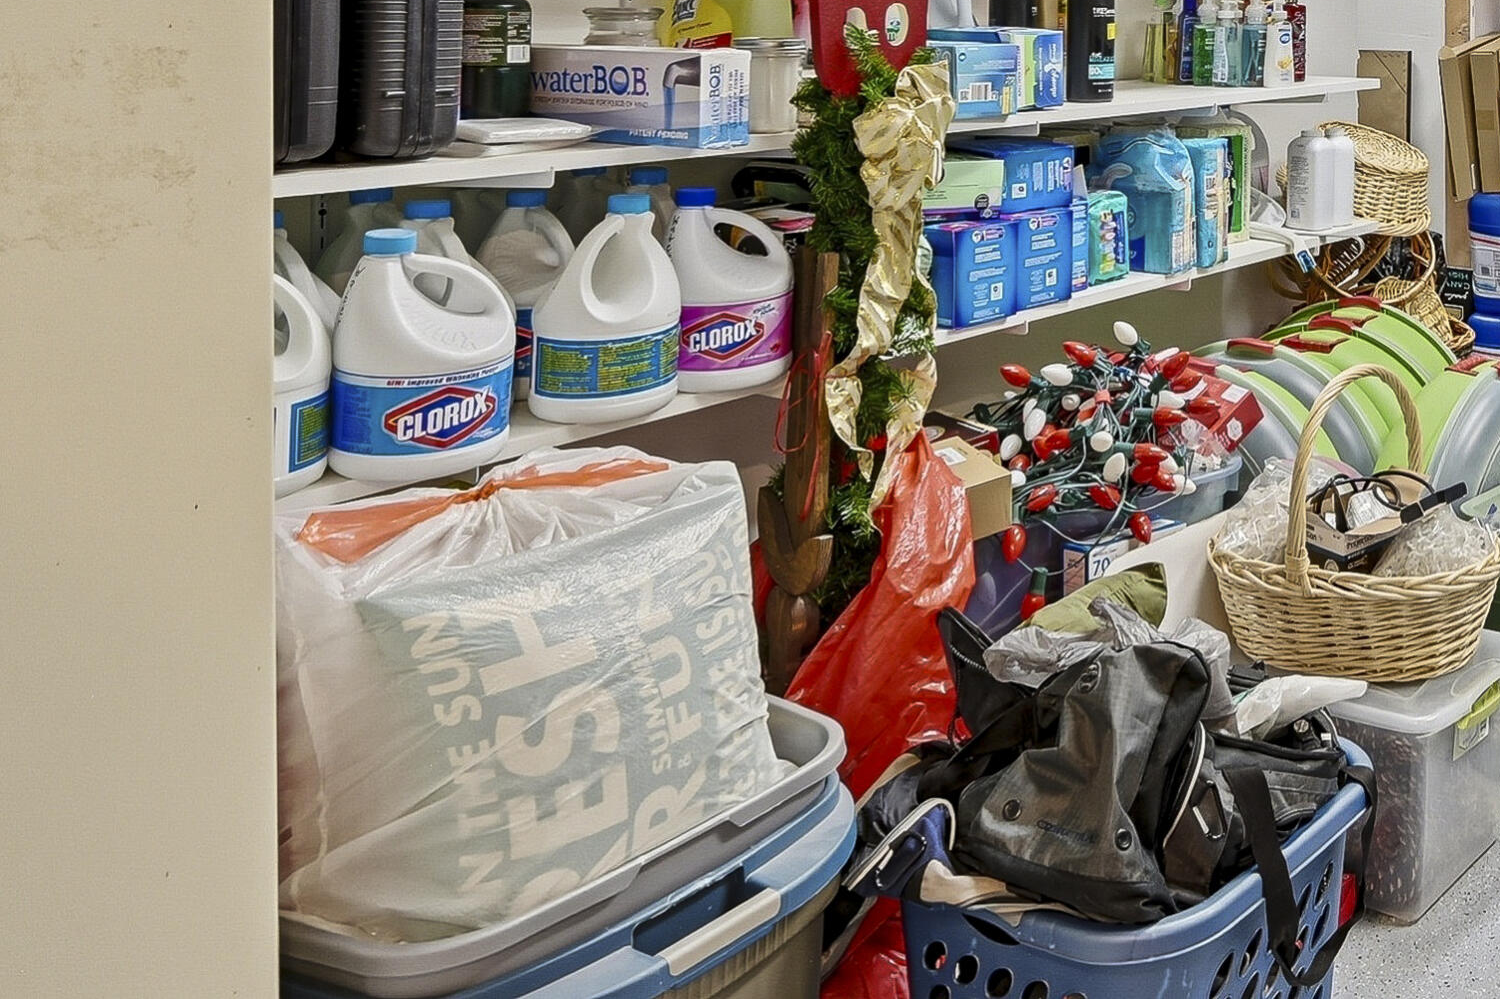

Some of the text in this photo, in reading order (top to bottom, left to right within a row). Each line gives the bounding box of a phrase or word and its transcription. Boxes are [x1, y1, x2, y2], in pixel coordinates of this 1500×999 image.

[689, 317, 759, 354] CLOROX
[396, 386, 490, 442] CLOROX
[403, 607, 483, 728] SUN
